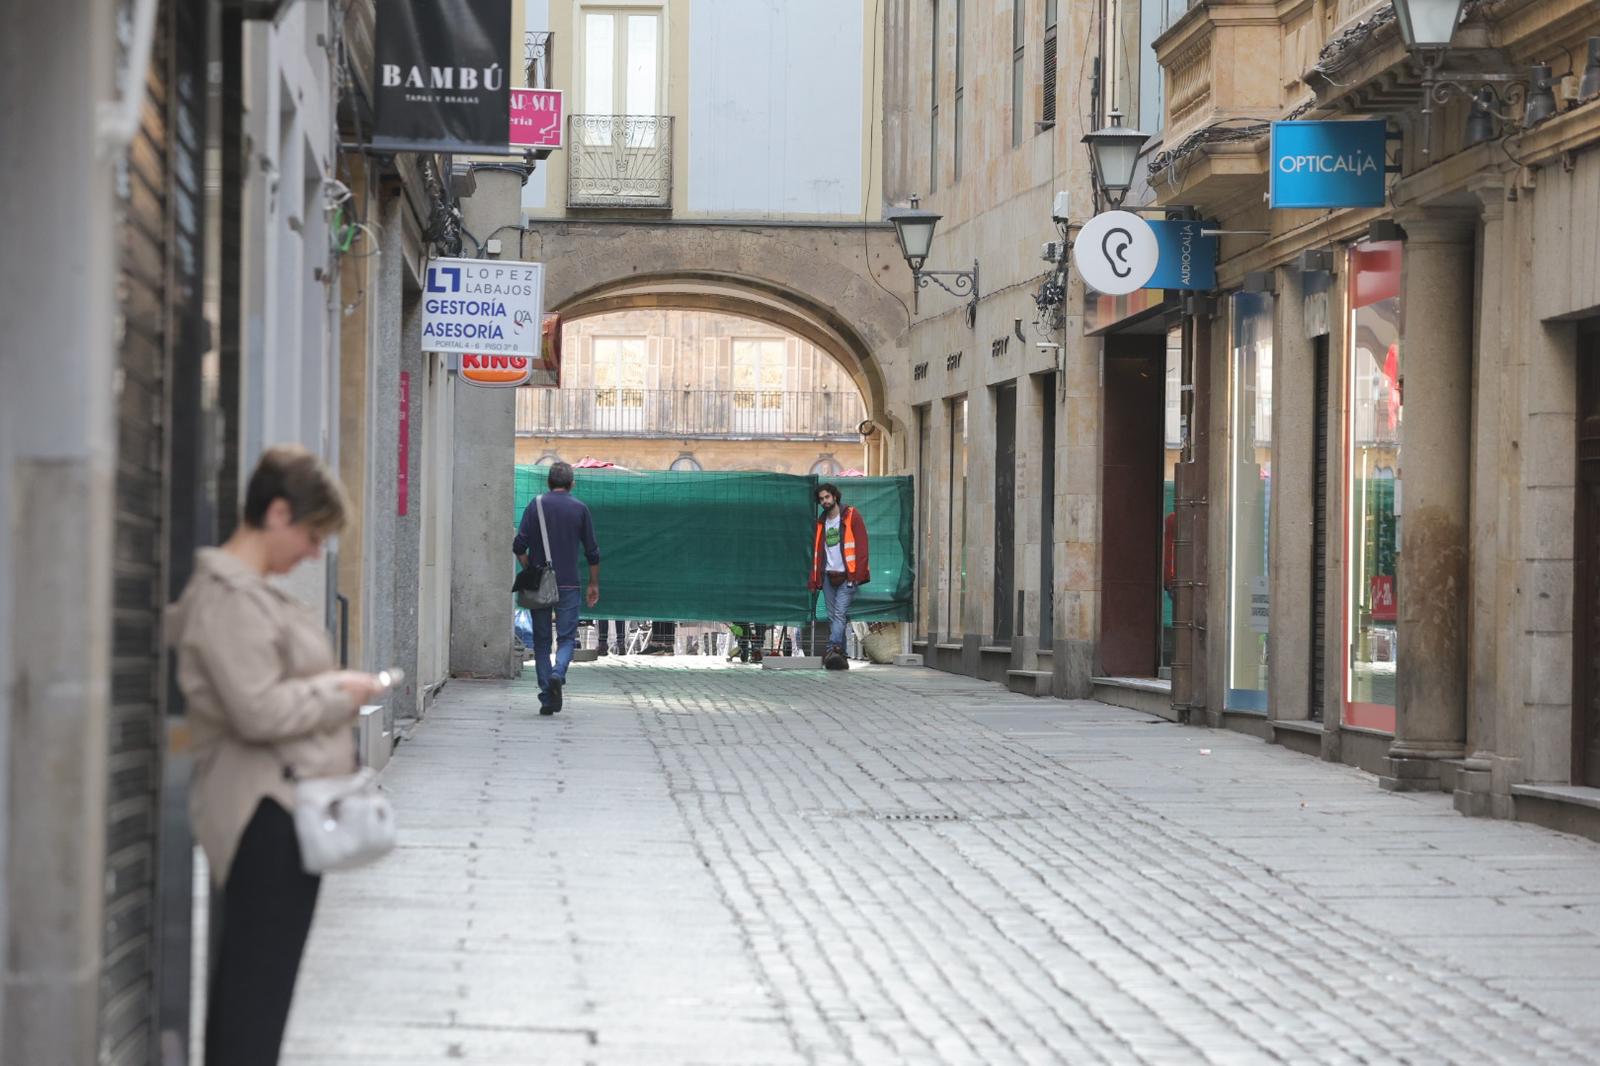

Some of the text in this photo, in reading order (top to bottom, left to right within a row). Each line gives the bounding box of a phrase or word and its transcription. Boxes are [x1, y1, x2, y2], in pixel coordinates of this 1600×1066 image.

[382, 63, 503, 91] BAMBÚ
[405, 94, 433, 103] TAPAS
[445, 96, 479, 105] BRASAS
[466, 268, 533, 281] LOPEZ
[466, 283, 531, 296] LABAJOS
[425, 298, 507, 317] GESTORÍA
[423, 320, 504, 340] ASESORÍA
[435, 340, 464, 349] PORTAL
[485, 342, 503, 351] PISO
[462, 354, 528, 369] KING
